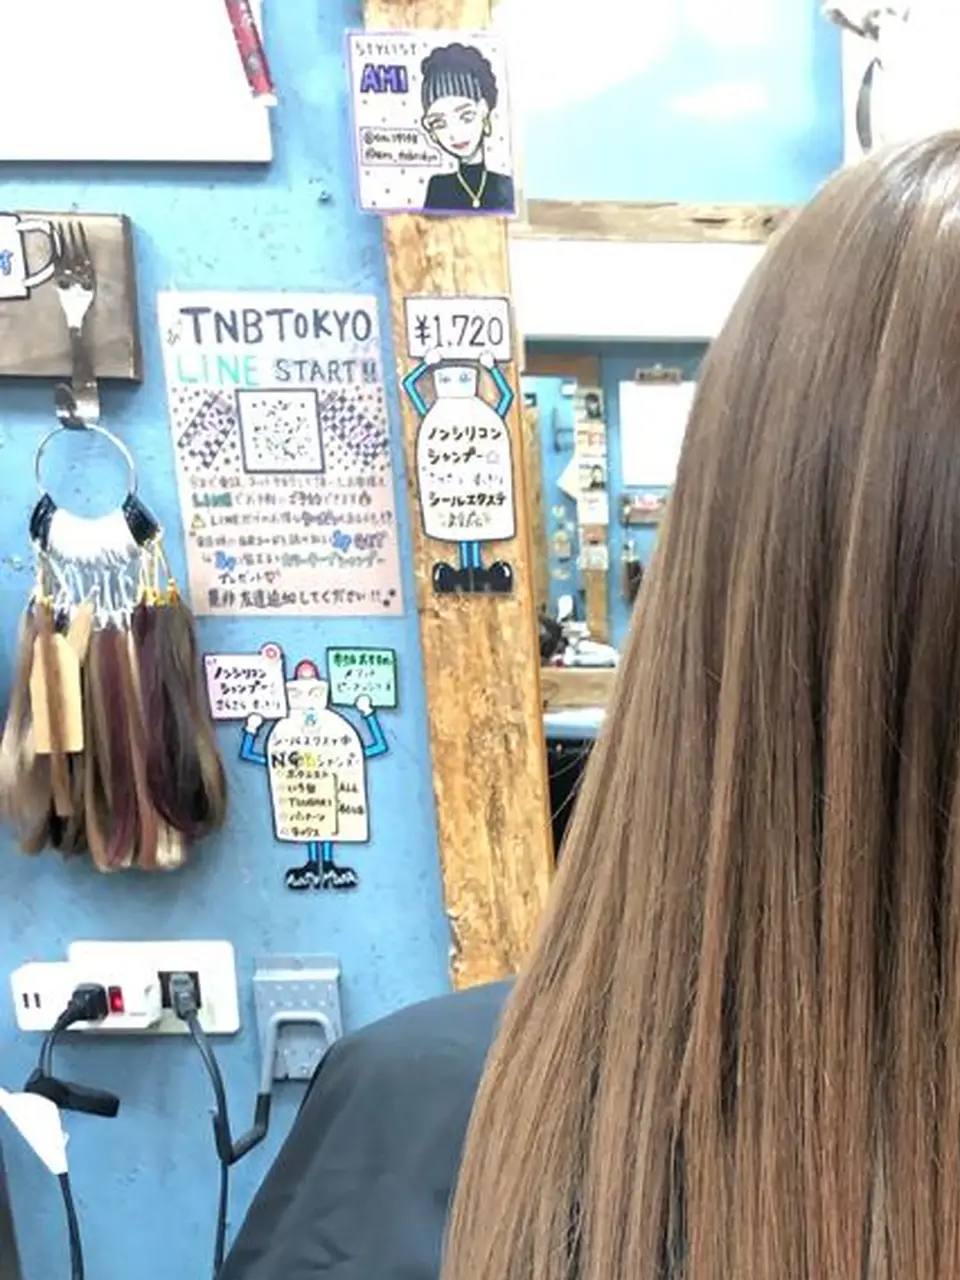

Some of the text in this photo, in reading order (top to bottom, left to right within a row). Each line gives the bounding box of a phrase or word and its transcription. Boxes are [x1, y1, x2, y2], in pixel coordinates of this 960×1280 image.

[355, 42, 417, 57] STYLIST
[360, 63, 408, 93] AMI
[179, 306, 372, 344] TNBTOKYO
[176, 354, 260, 385] LINE
[428, 425, 502, 442] ノンシリコン
[428, 446, 484, 465] シャンプー
[429, 491, 507, 508] シールエクステ
[213, 666, 267, 680] ノンシリコン
[220, 680, 268, 695] シャンプー
